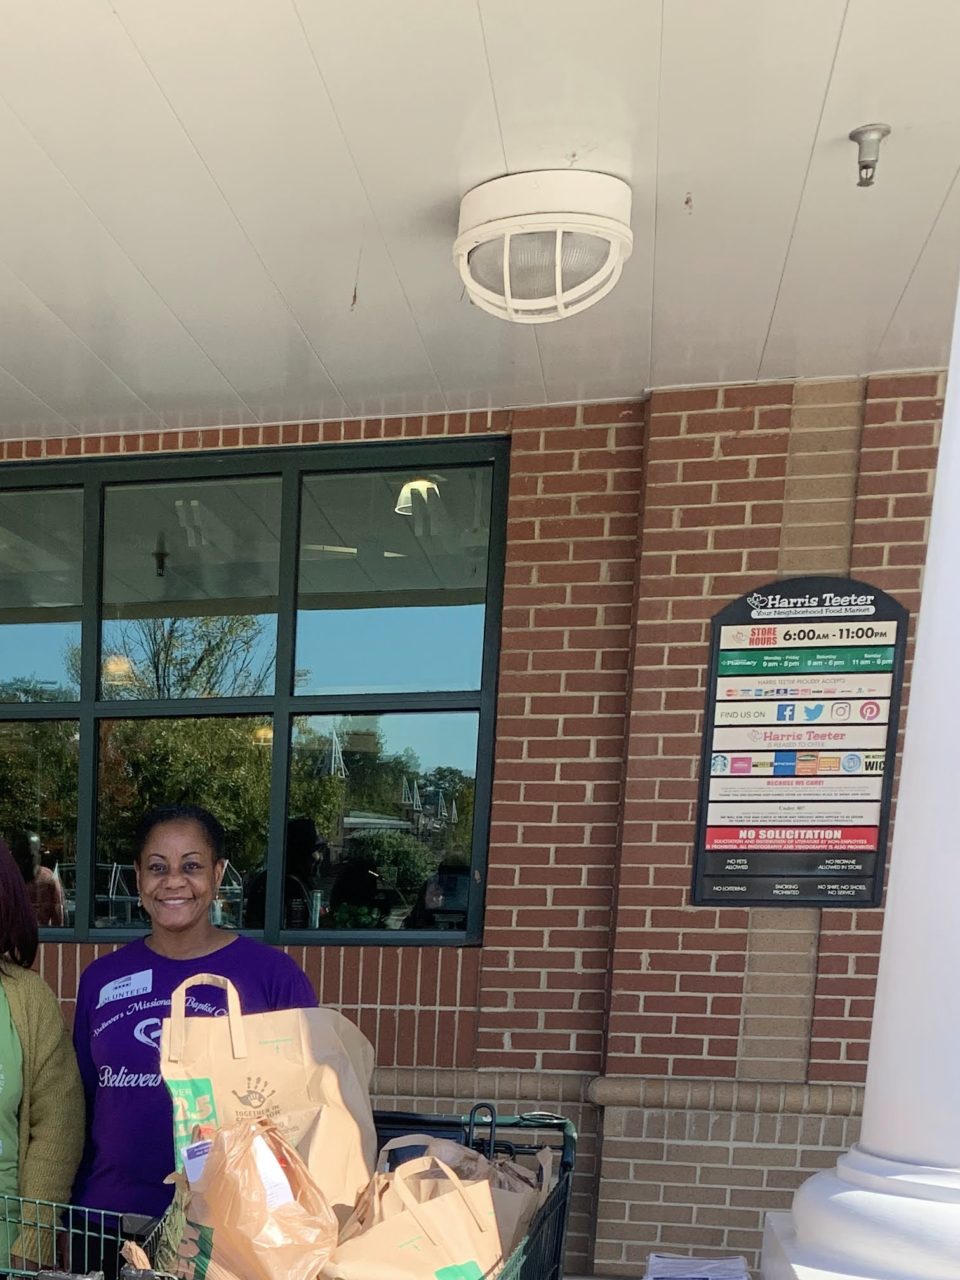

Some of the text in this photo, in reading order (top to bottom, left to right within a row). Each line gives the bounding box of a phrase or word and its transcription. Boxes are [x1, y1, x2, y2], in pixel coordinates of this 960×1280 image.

[767, 593, 875, 608] Harris Teeter
[773, 608, 824, 617] Neighborhood
[750, 628, 777, 637] STORE
[749, 637, 777, 646] HOURS
[763, 730, 846, 742] Harris Teeter
[865, 760, 885, 771] WIC
[739, 829, 842, 839] NO SOLICITATION
[102, 986, 149, 1003] OLUNTEER
[126, 998, 172, 1015] Missiona
[185, 996, 217, 1013] Baptist
[99, 1065, 162, 1088] Believers
